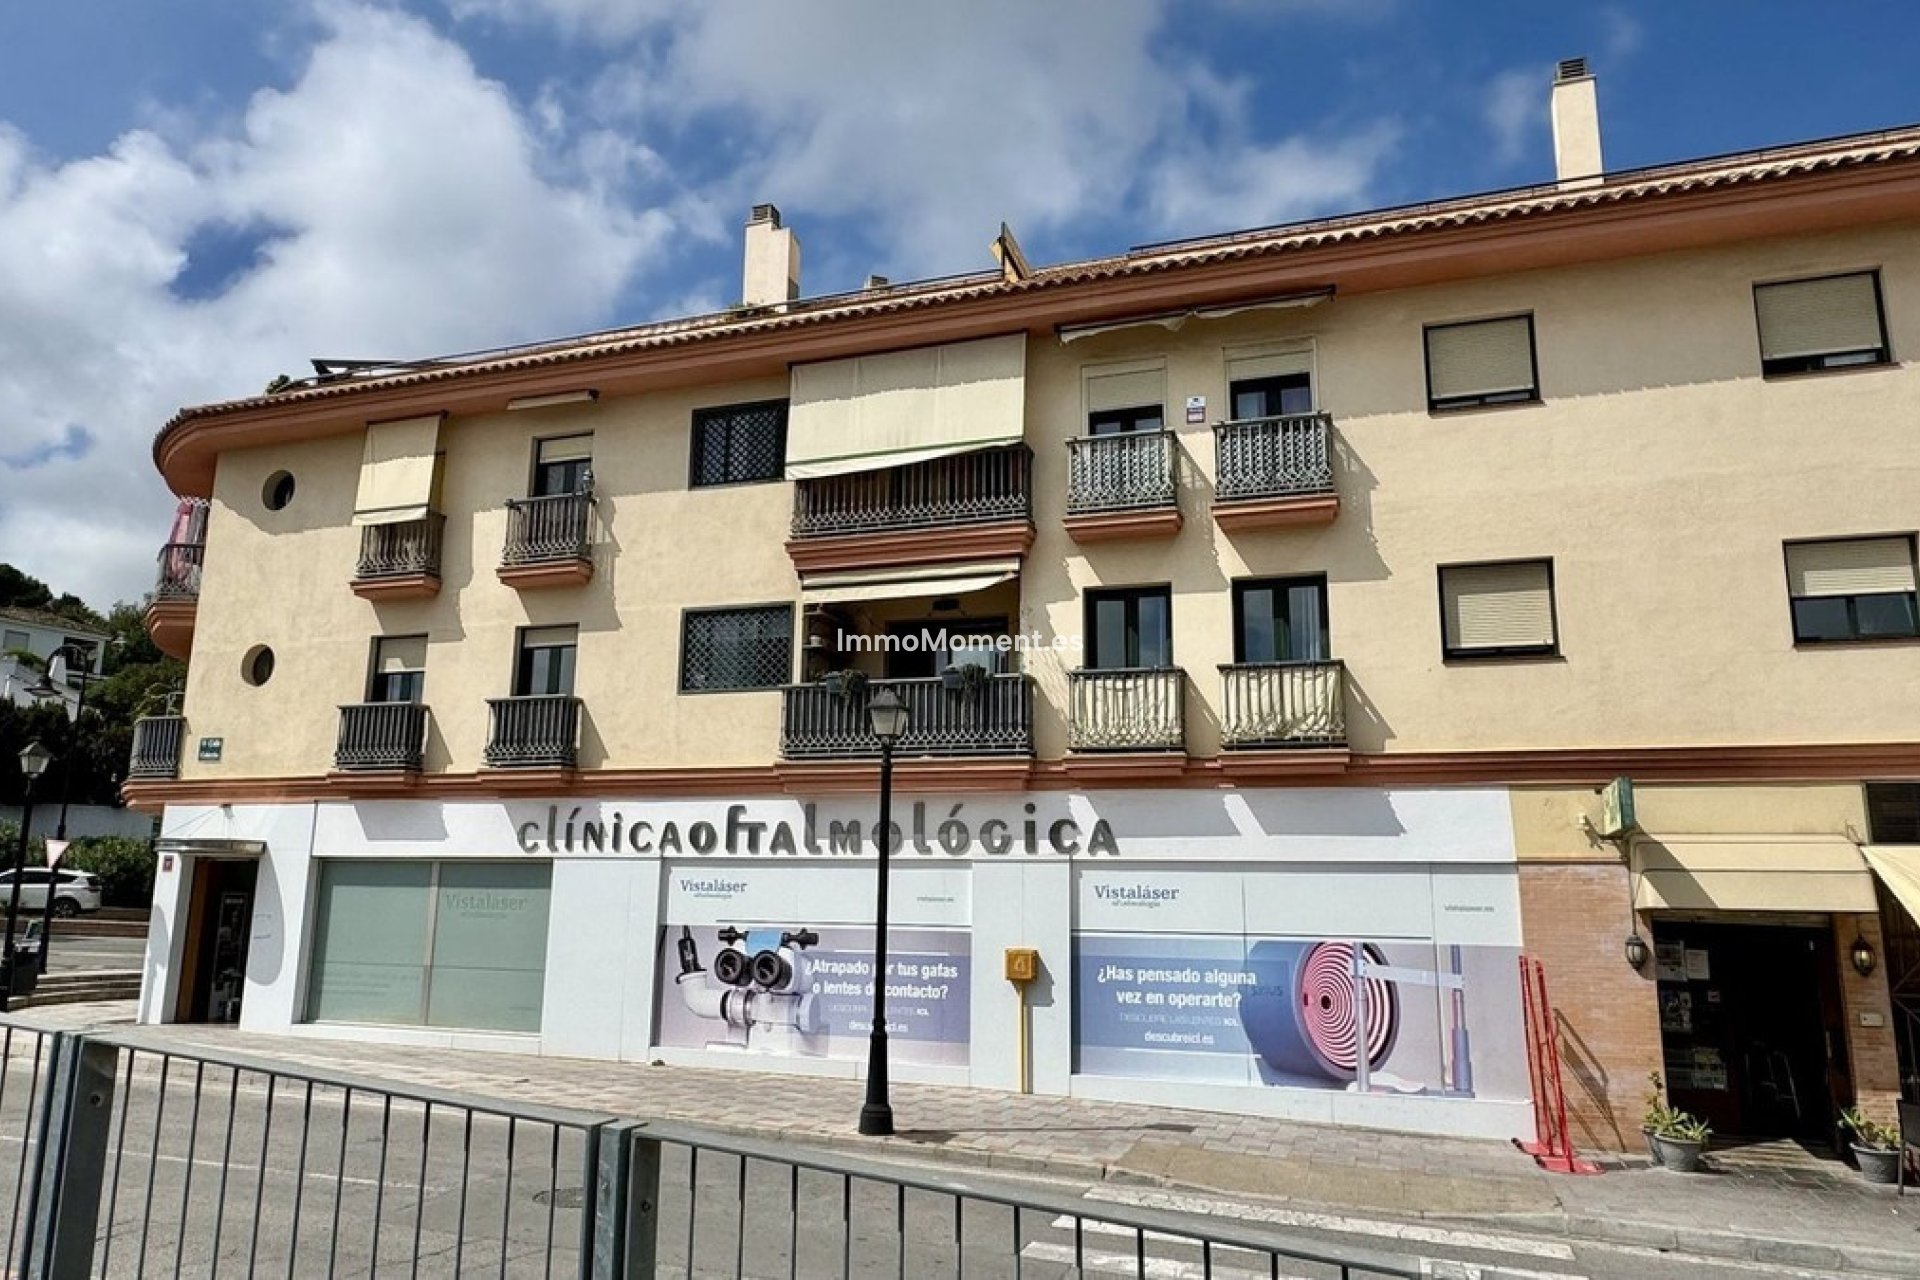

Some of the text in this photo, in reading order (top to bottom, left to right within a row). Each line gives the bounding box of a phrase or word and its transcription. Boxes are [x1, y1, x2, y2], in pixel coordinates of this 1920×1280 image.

[1094, 883, 1180, 900] Vistaláser
[805, 959, 869, 976] ¿Atrapado
[897, 962, 918, 976] tus
[921, 963, 958, 980] gafas
[1097, 964, 1257, 988] ¿Has pensado alguna
[812, 982, 821, 994] o
[824, 980, 862, 995] lentes
[885, 984, 948, 999] contacto?
[1116, 991, 1242, 1009] vez en operarte?
